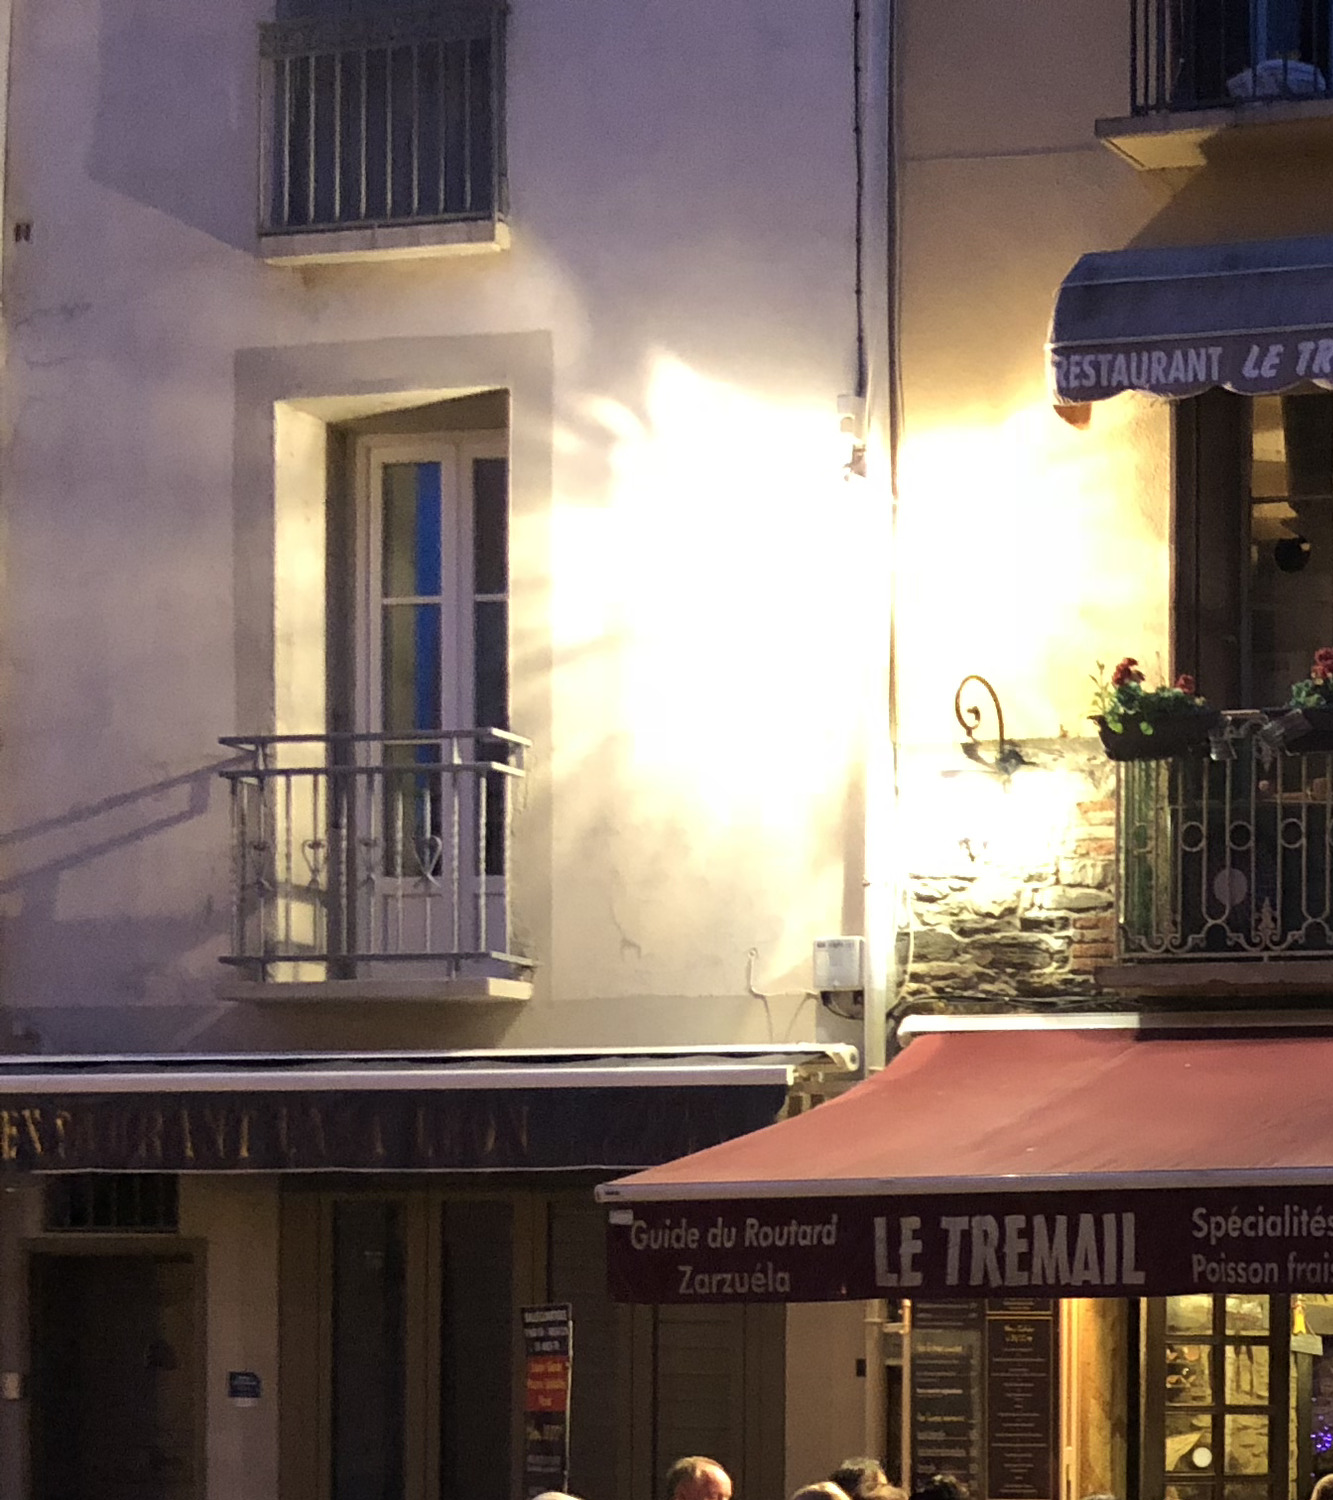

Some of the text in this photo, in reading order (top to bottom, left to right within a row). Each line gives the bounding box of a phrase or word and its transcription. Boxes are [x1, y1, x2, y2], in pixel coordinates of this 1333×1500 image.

[1053, 347, 1223, 389] RESTAURANT
[1241, 344, 1285, 379] LE
[630, 1213, 838, 1250] Guide du Routard
[873, 1211, 1146, 1288] LE TREMAIL
[677, 1261, 791, 1295] Zarzuéla
[1191, 1252, 1279, 1284] Poisson
